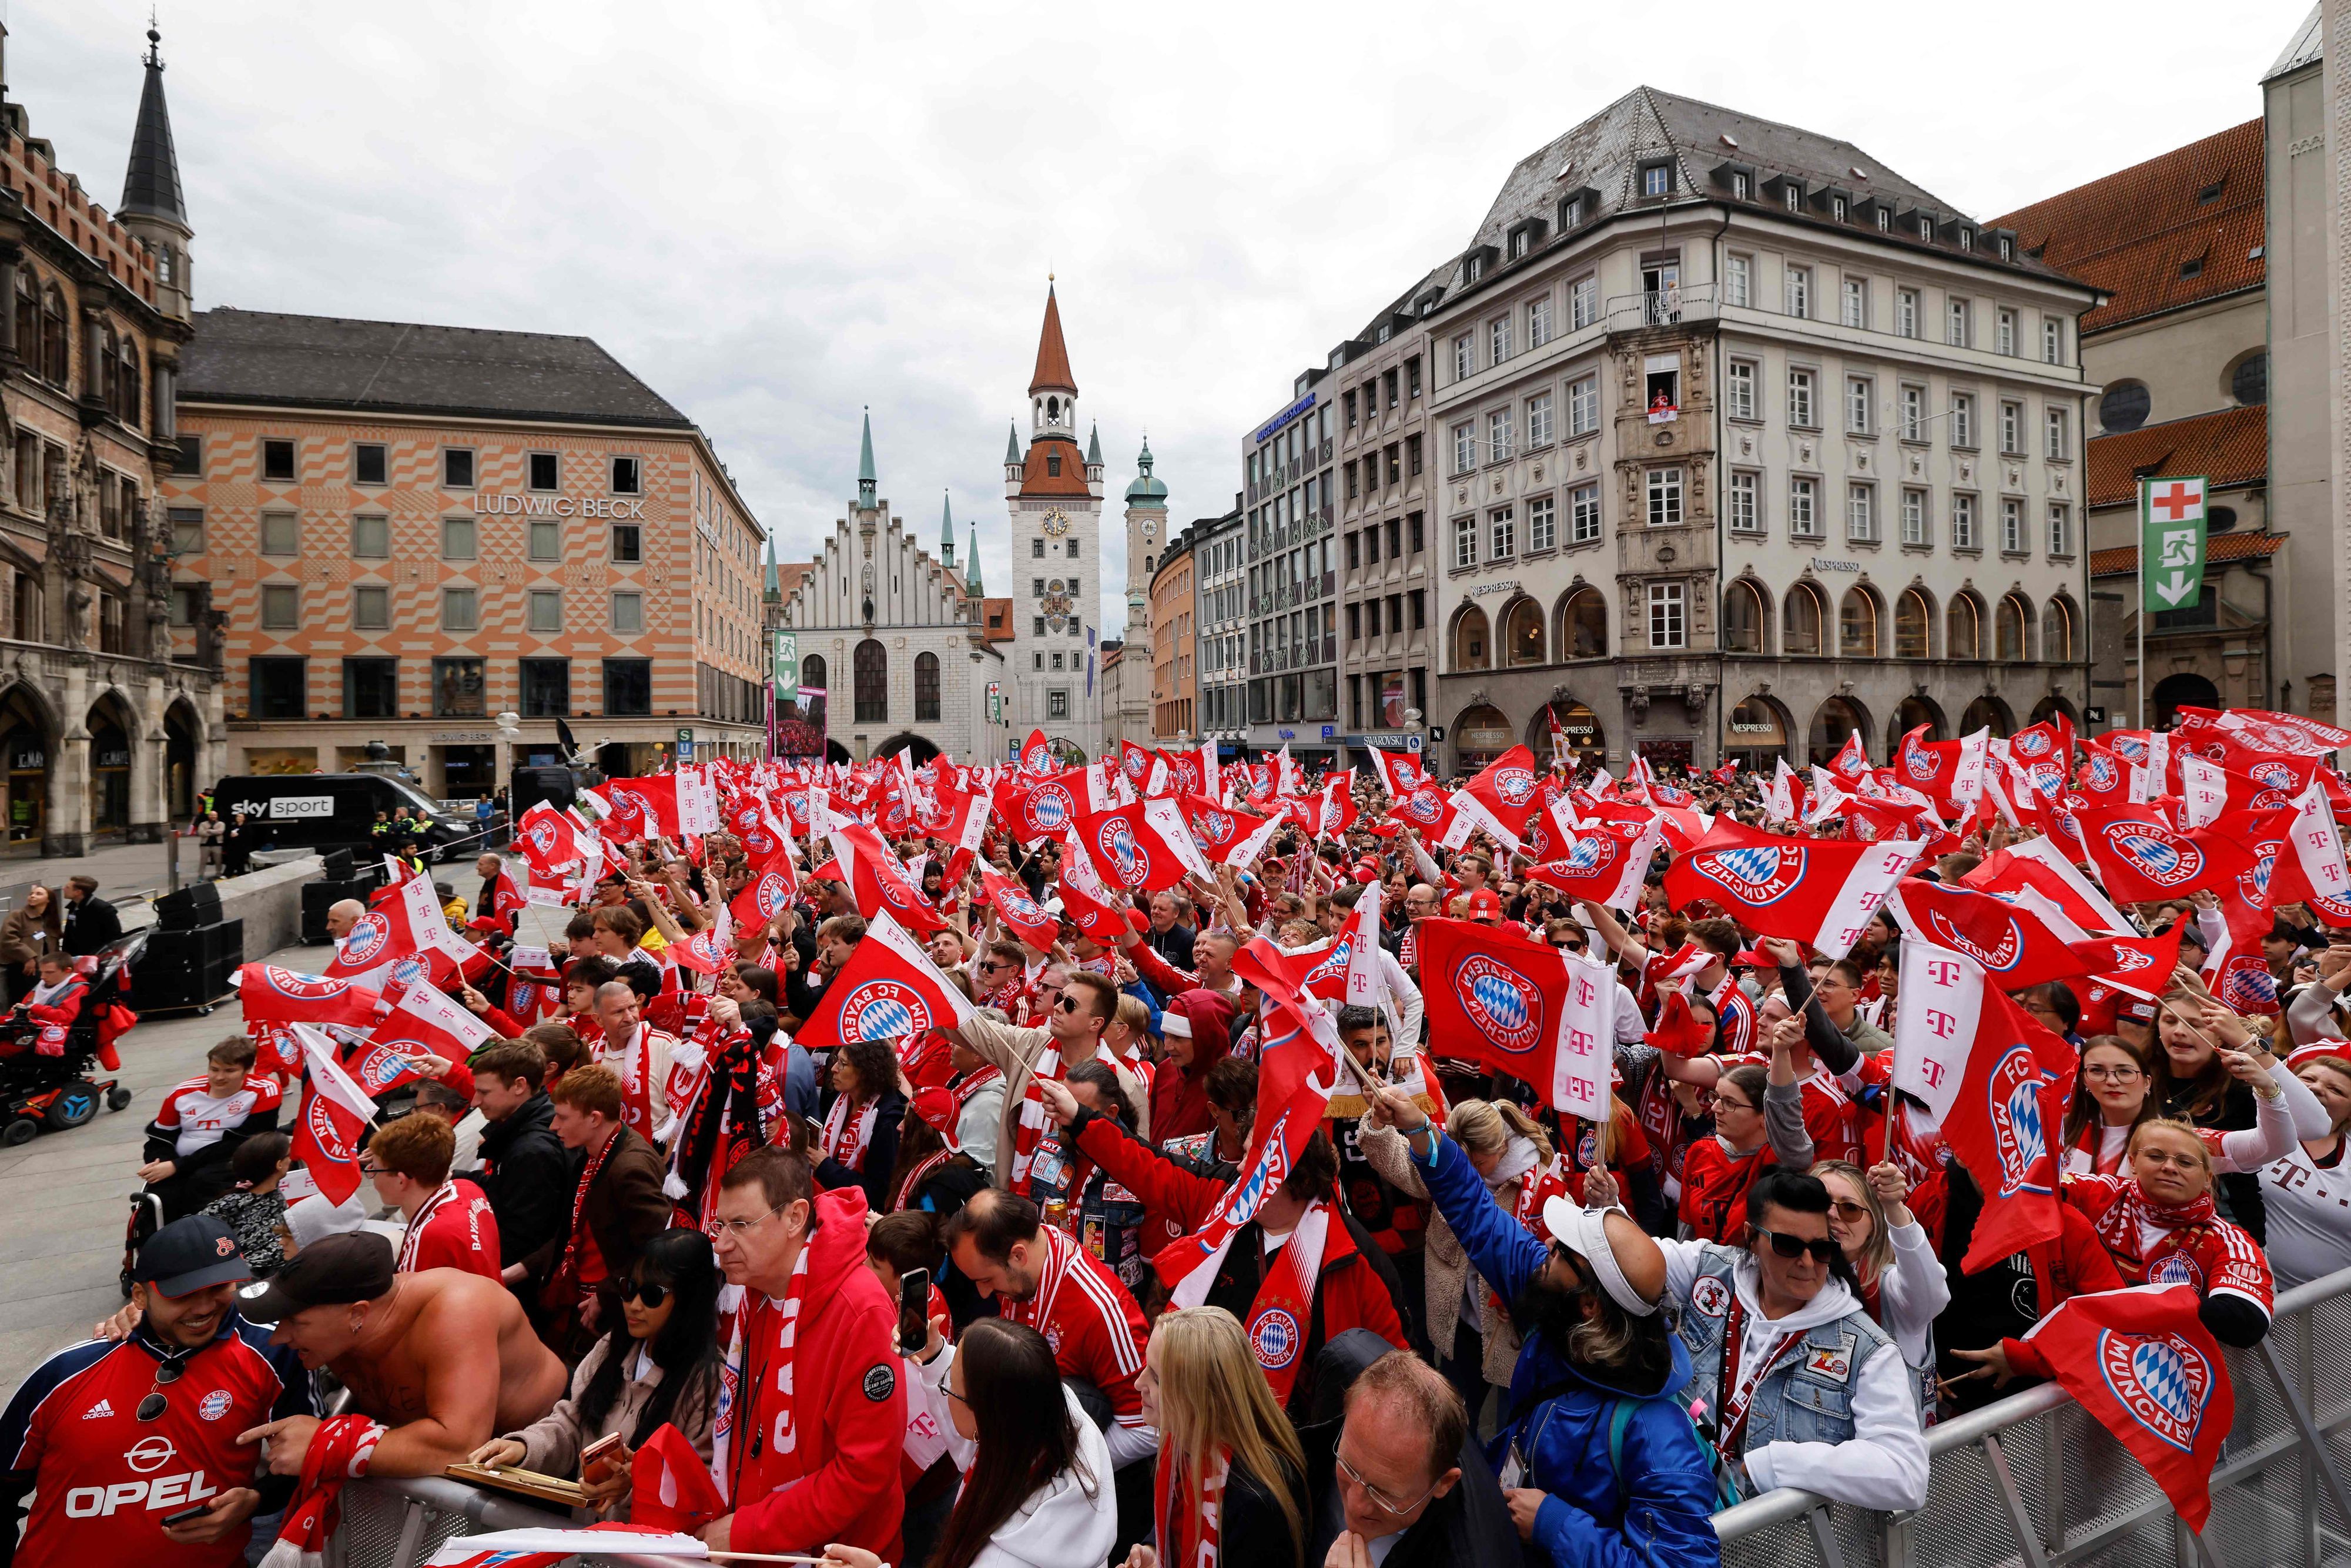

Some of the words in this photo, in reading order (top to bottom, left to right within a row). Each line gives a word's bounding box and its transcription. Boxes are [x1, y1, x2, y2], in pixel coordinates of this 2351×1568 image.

[1256, 392, 1316, 443] AUGENTAGESKLINIK
[474, 494, 575, 515] LUDWIG
[583, 499, 645, 520] BECK
[1811, 557, 1860, 572] NESPRESSO
[1471, 579, 1516, 597] NESPRESSO
[431, 733, 467, 742] LUDWIG
[680, 730, 689, 741] S
[1560, 726, 1593, 734] SPRESSO
[1733, 722, 1772, 733] NESPRESSO
[680, 743, 689, 753] U
[1011, 740, 1019, 748] S
[1364, 736, 1402, 746] SWAROVSKI
[1012, 751, 1019, 760] U
[231, 799, 268, 817] sky
[275, 800, 329, 815] sport
[2256, 795, 2270, 808] FC
[2108, 825, 2178, 845] BAYERN
[2129, 852, 2196, 884] MÜNCHEN
[1928, 960, 1960, 987] T
[2245, 959, 2262, 969] FC
[1578, 975, 1595, 1008] T
[2227, 968, 2263, 1013] MÜNCHEN
[1927, 1009, 1955, 1040] T
[1571, 1028, 1594, 1057] T
[1922, 1057, 1945, 1090] T
[2004, 1056, 2029, 1084] FC
[1571, 1076, 1595, 1103] T
[197, 1120, 220, 1131] T
[1647, 1102, 1665, 1134] FC
[2219, 1276, 2263, 1298] Allianz
[1260, 1318, 1271, 1328] FC
[1271, 1314, 1295, 1342] BAYERN
[1252, 1335, 1291, 1365] MÜNCHEN
[880, 1377, 890, 1385] DAVID
[2169, 1338, 2203, 1421] BAYERN
[202, 1395, 212, 1404] FC
[212, 1391, 230, 1406] BAYERN
[2108, 1338, 2192, 1443] MÜNCHEN
[82, 1410, 115, 1420] adidas
[200, 1407, 227, 1420] MÜNCHEN
[66, 1470, 217, 1519] OPEL
